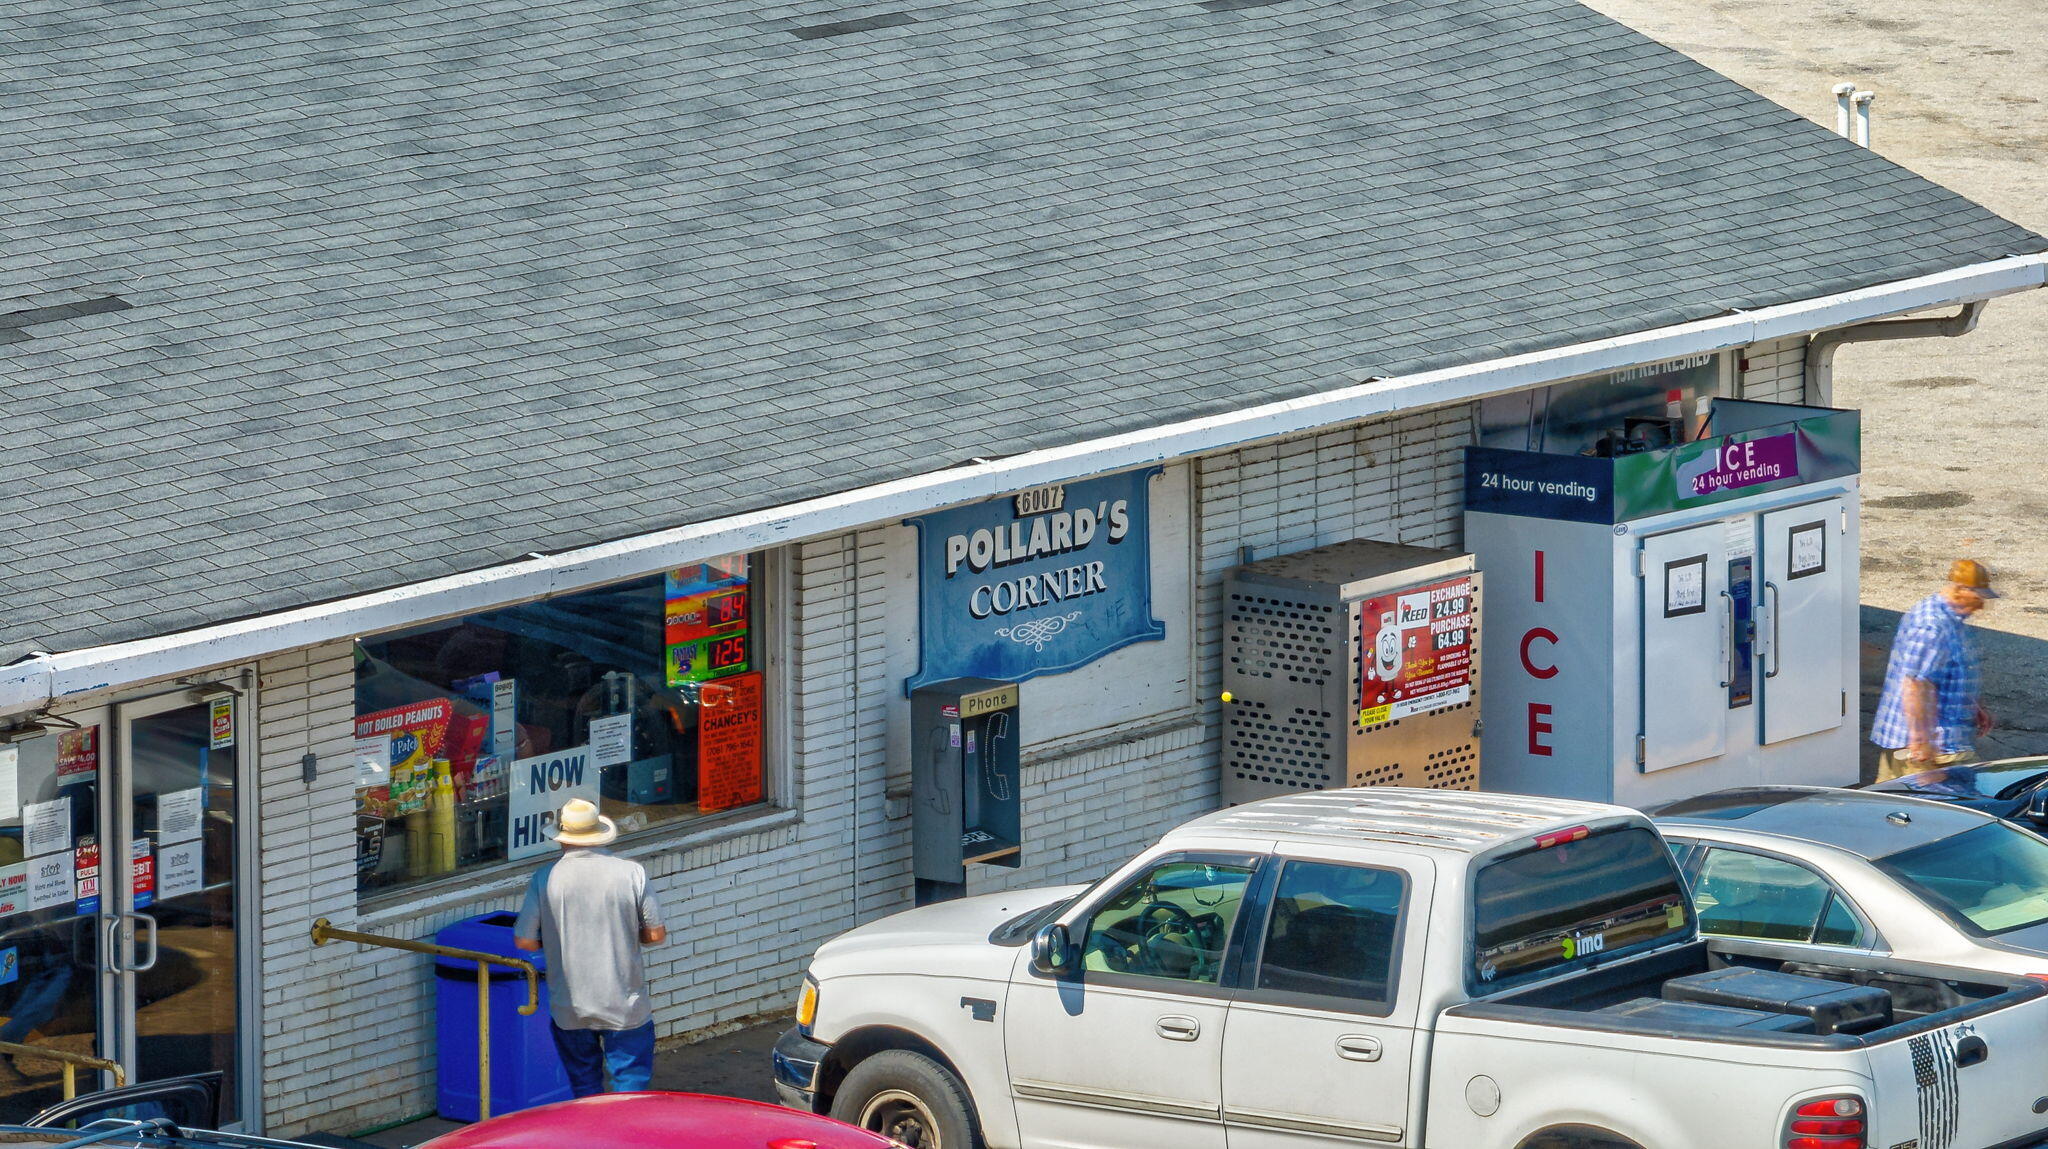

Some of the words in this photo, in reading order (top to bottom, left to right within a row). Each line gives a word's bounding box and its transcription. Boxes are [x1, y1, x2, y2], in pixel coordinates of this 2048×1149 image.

[1714, 442, 1756, 473] ICE
[1481, 472, 1499, 488] 24
[1502, 474, 1534, 493] hour
[1537, 480, 1597, 502] vending
[1692, 476, 1705, 492] 24
[1709, 471, 1733, 488] hour
[1737, 462, 1781, 482] vending
[1022, 486, 1060, 513] 6007
[947, 499, 1129, 578] POLLARD'S
[969, 560, 1107, 619] CORNER
[1431, 582, 1470, 603] EXCHANGE
[720, 595, 745, 622] 84
[1401, 604, 1428, 623] REED
[1436, 597, 1464, 619] 24.99
[1430, 614, 1470, 636] PURCHASE
[715, 637, 744, 665] 125
[1437, 629, 1464, 649] 64.99
[1519, 549, 1560, 757] ICE
[969, 694, 1008, 712] Phone
[357, 720, 374, 736] HOT
[375, 713, 403, 732] BOILED
[405, 705, 444, 725] PEANUTS
[703, 709, 758, 732] CHANCEY'S
[397, 736, 418, 756] Patch
[59, 755, 77, 765] SAVE
[530, 754, 586, 796] NOW
[513, 808, 563, 849] HIR
[8, 873, 27, 886] NOW!
[41, 862, 61, 879] STOP
[133, 861, 152, 876] EBT
[1576, 931, 1604, 957] ima
